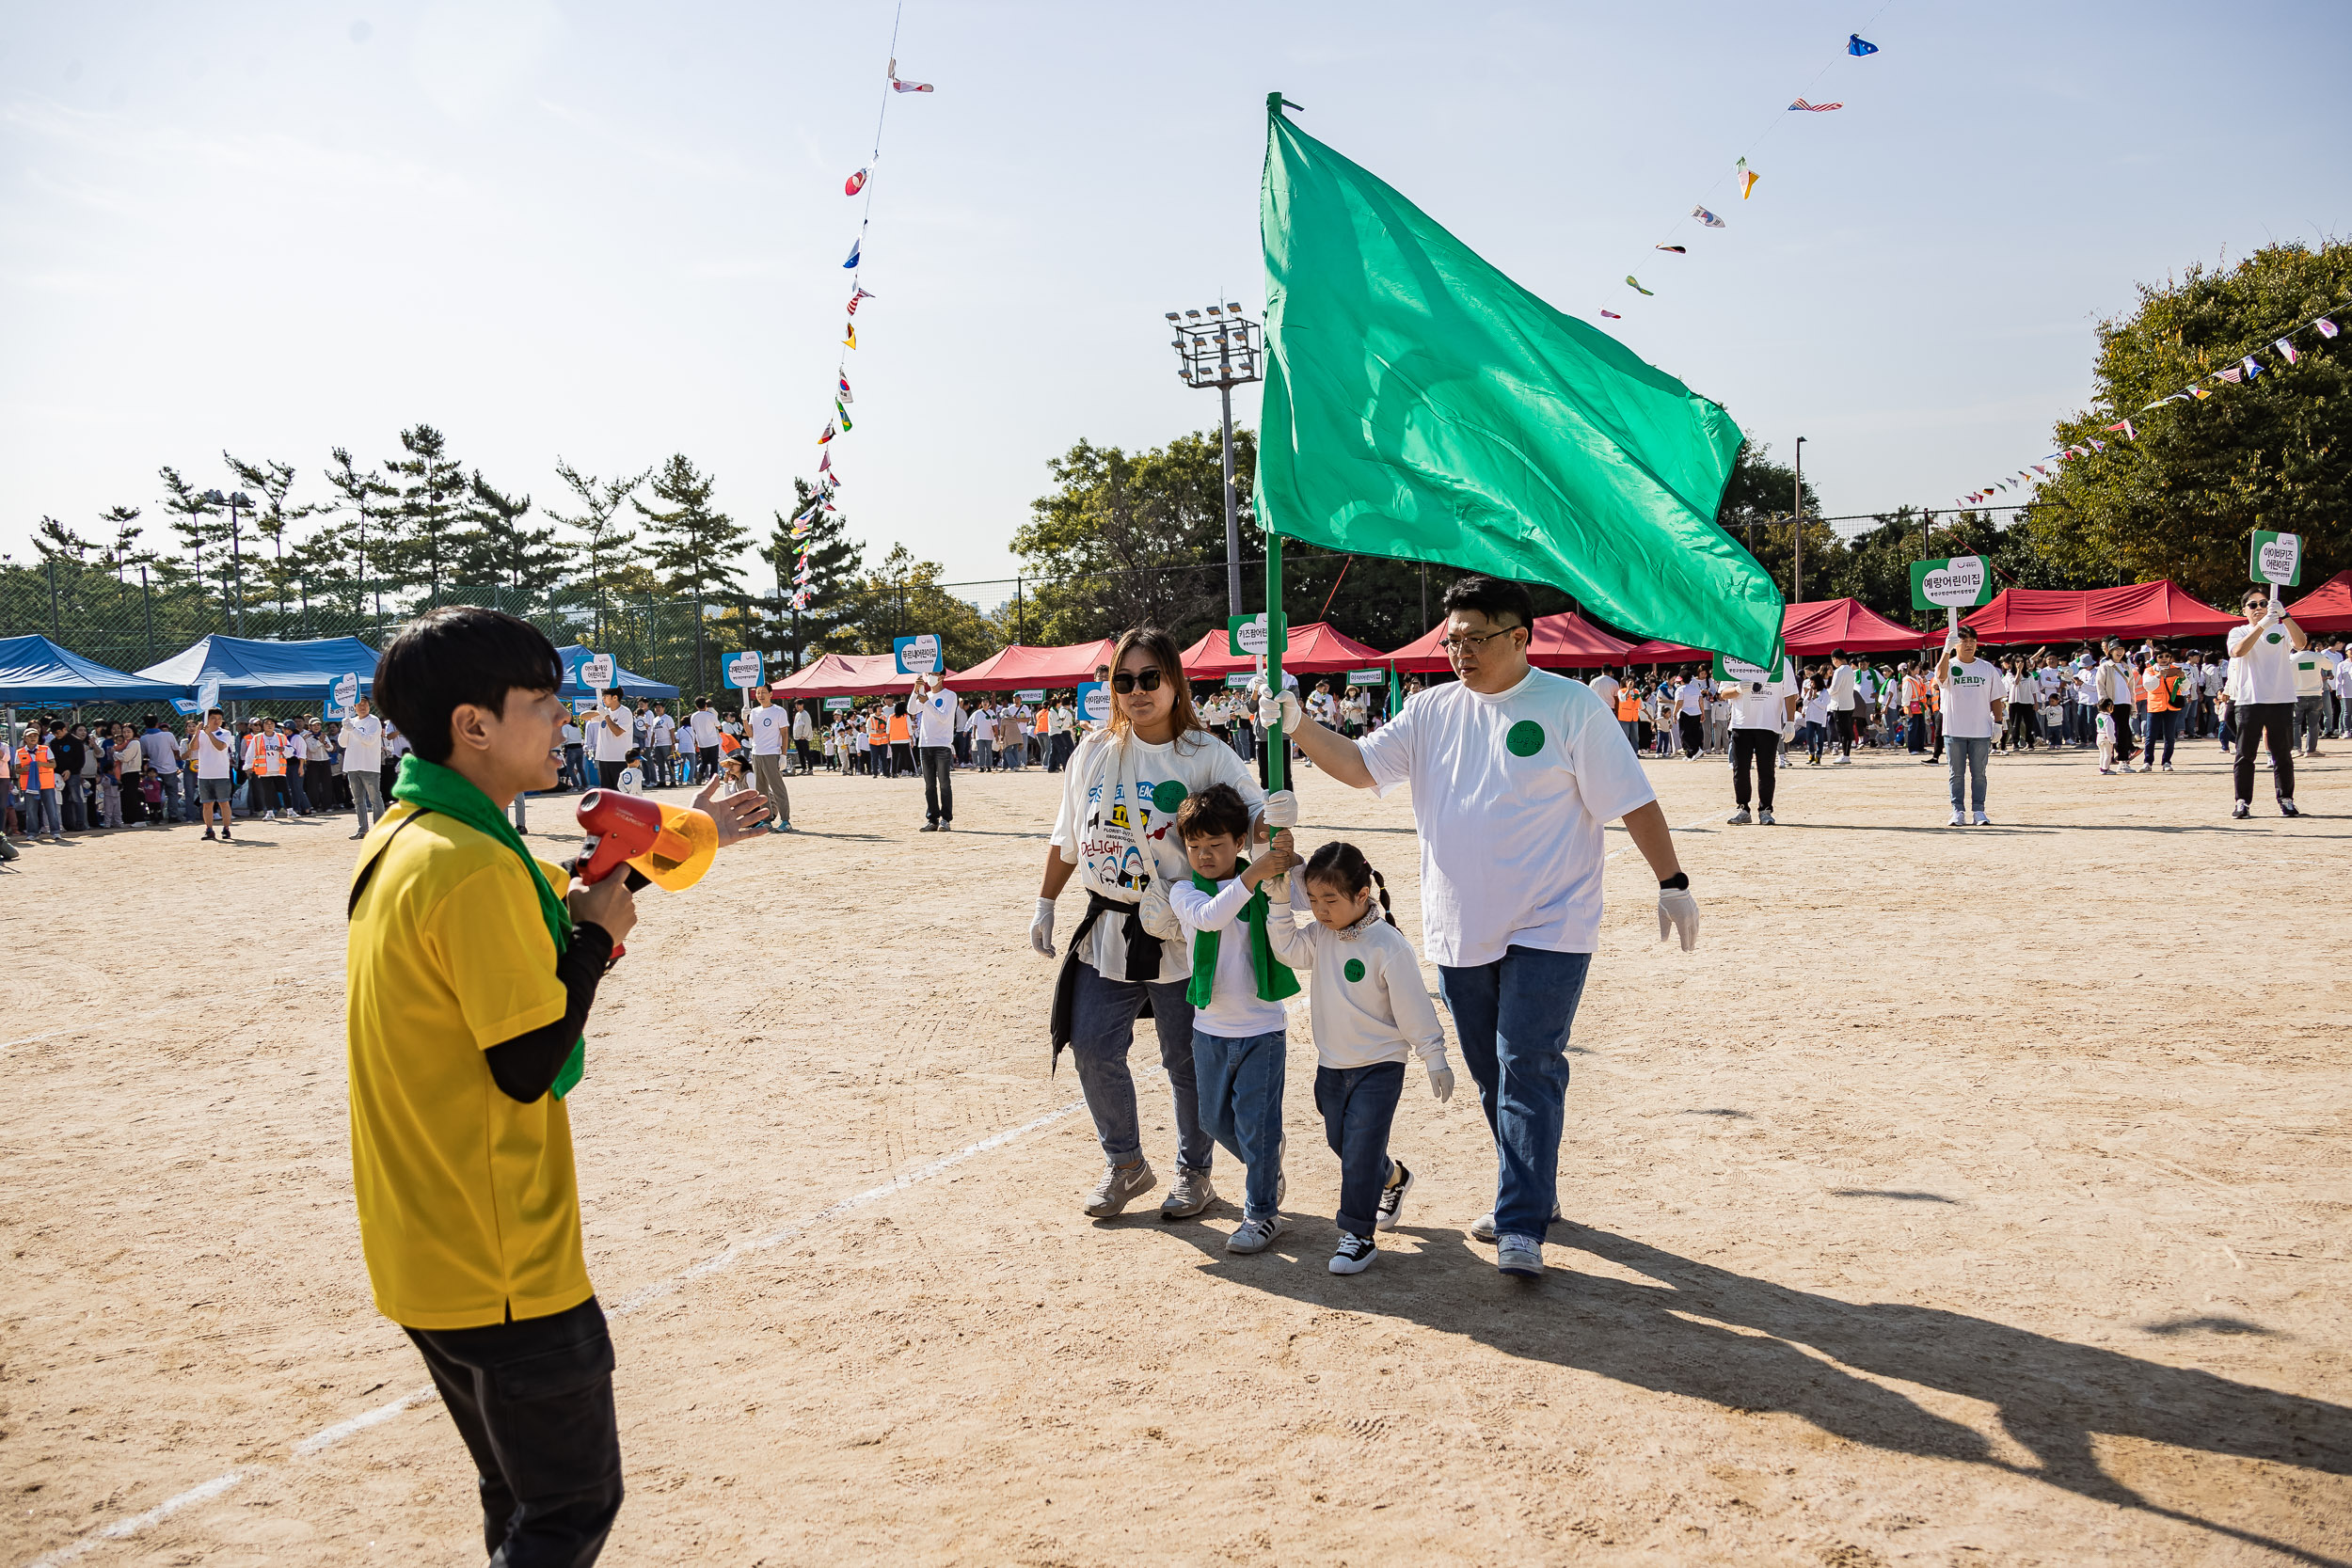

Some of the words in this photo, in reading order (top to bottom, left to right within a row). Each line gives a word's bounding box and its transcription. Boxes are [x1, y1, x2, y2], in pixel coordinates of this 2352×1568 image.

[2266, 559, 2290, 572] 어린이집
[1924, 574, 1980, 589] 예랑어린이집
[1238, 627, 1268, 639] 키즈팜어린
[1953, 676, 1986, 685] NERDY
[1081, 839, 1122, 858] DELIGHT
